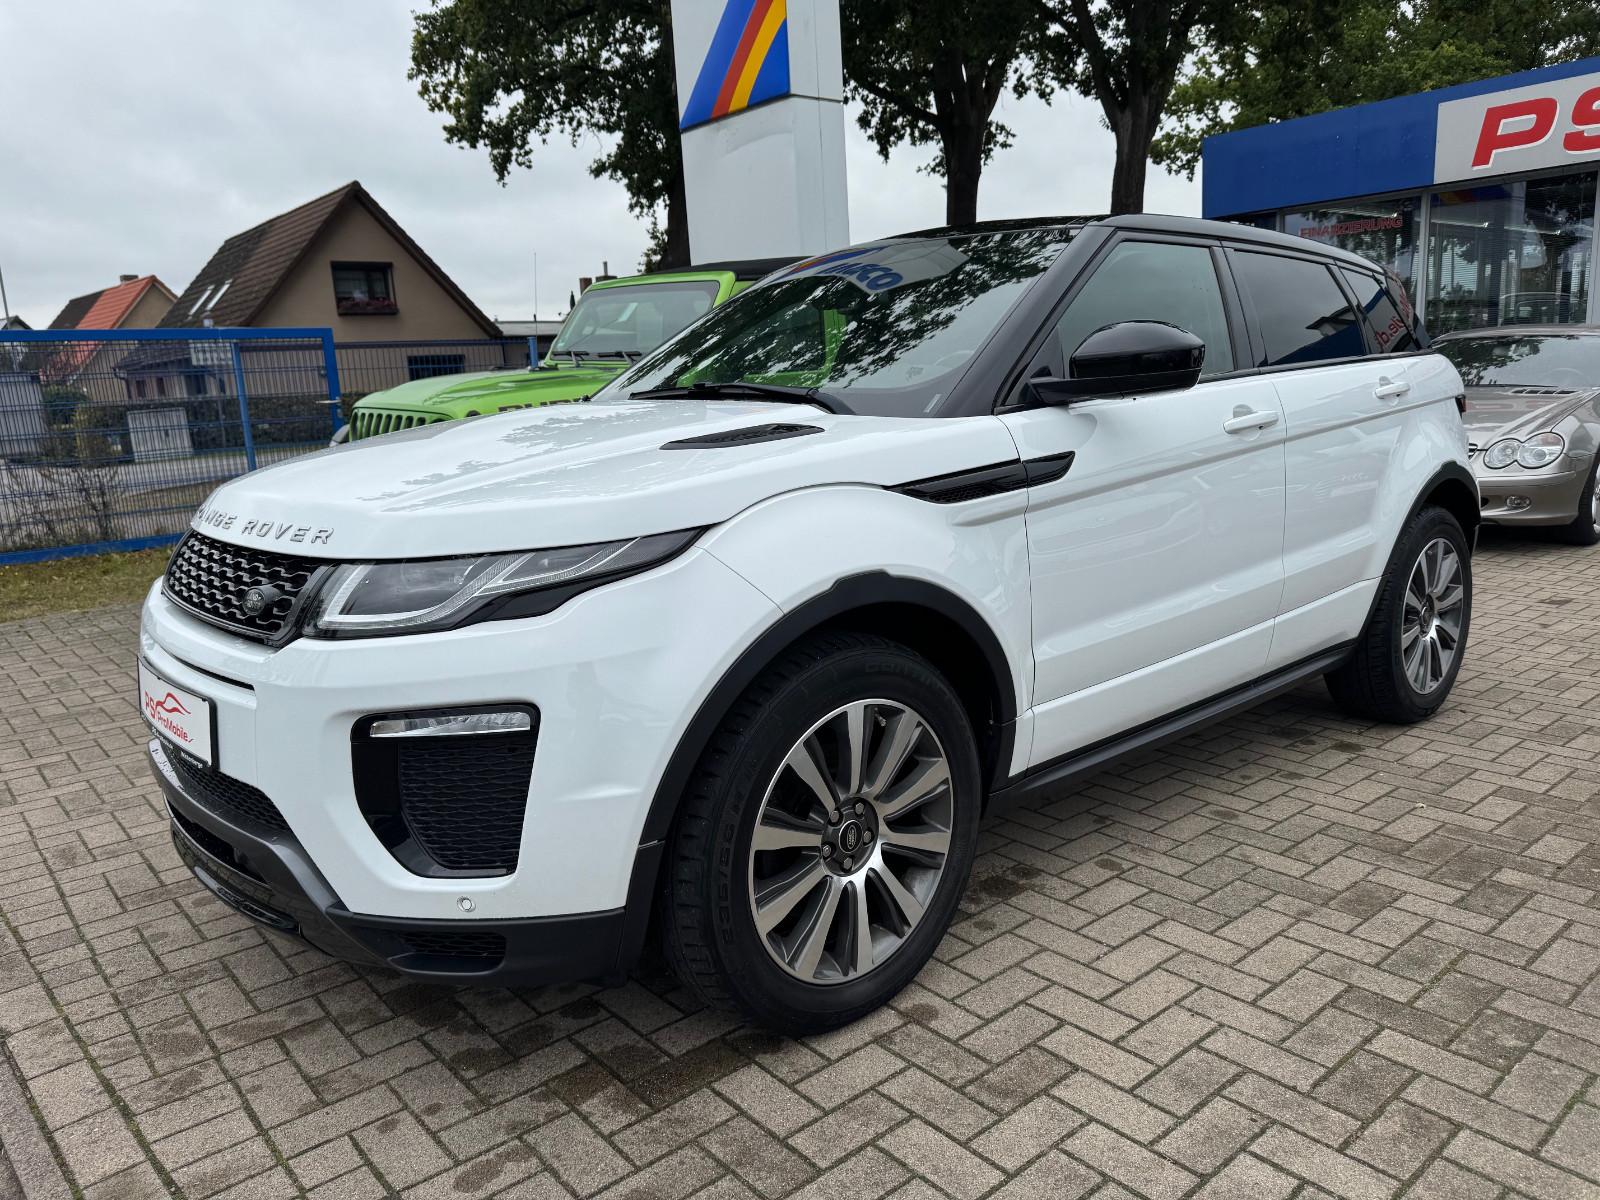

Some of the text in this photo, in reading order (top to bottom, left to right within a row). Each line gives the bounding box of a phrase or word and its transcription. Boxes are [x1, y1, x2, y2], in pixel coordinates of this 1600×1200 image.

[1299, 217, 1403, 238] FINANZIERUNG
[241, 518, 335, 544] ROVER
[144, 690, 156, 719] PS
[157, 712, 189, 742] ProMobile
